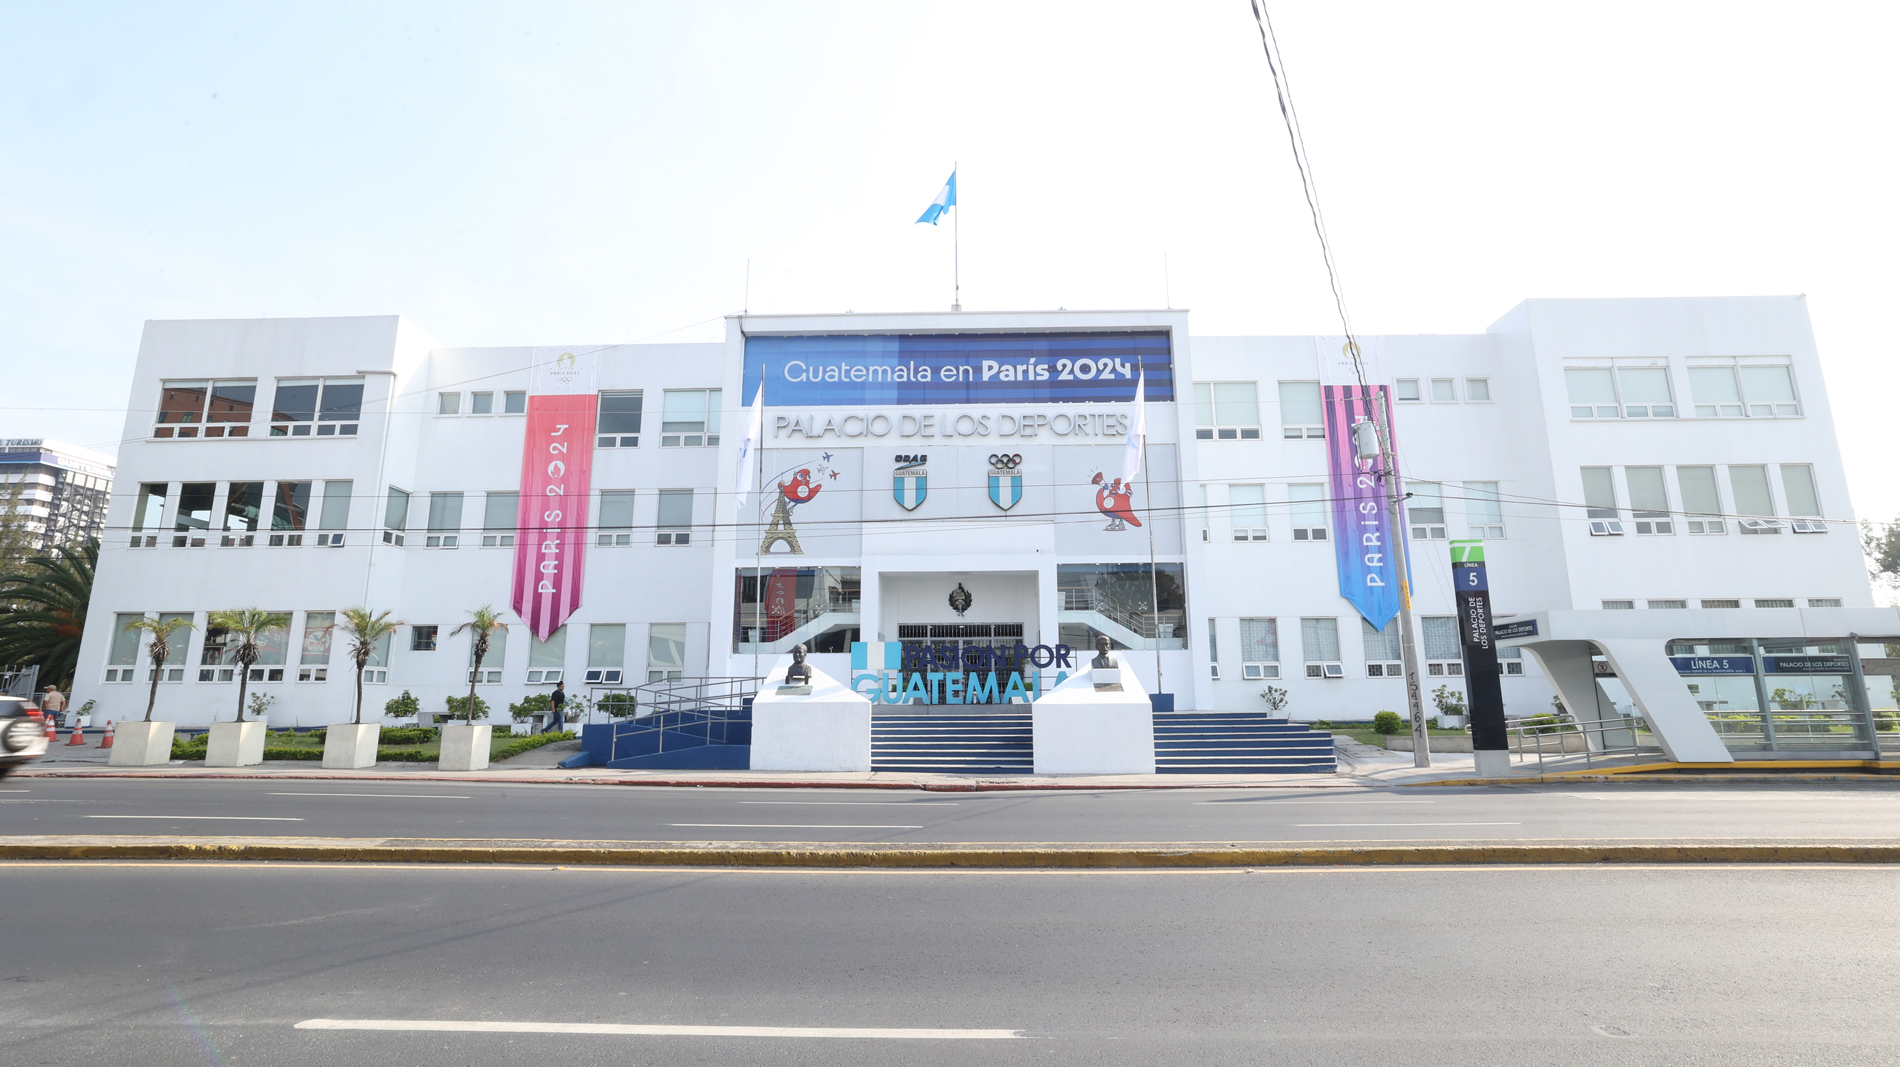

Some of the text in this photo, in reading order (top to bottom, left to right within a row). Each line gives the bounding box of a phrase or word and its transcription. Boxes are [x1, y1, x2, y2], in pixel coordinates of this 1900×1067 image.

[784, 357, 1132, 382] Guatemala en París 2024
[774, 412, 1129, 438] PALACIO DE LOS DEPORTES
[1468, 572, 1478, 586] 5
[1468, 597, 1480, 642] PALACIO DE
[1476, 596, 1489, 649] LOS DEPORTES
[905, 643, 1072, 670] PASION POR
[1691, 657, 1729, 669] LÍNEA 5
